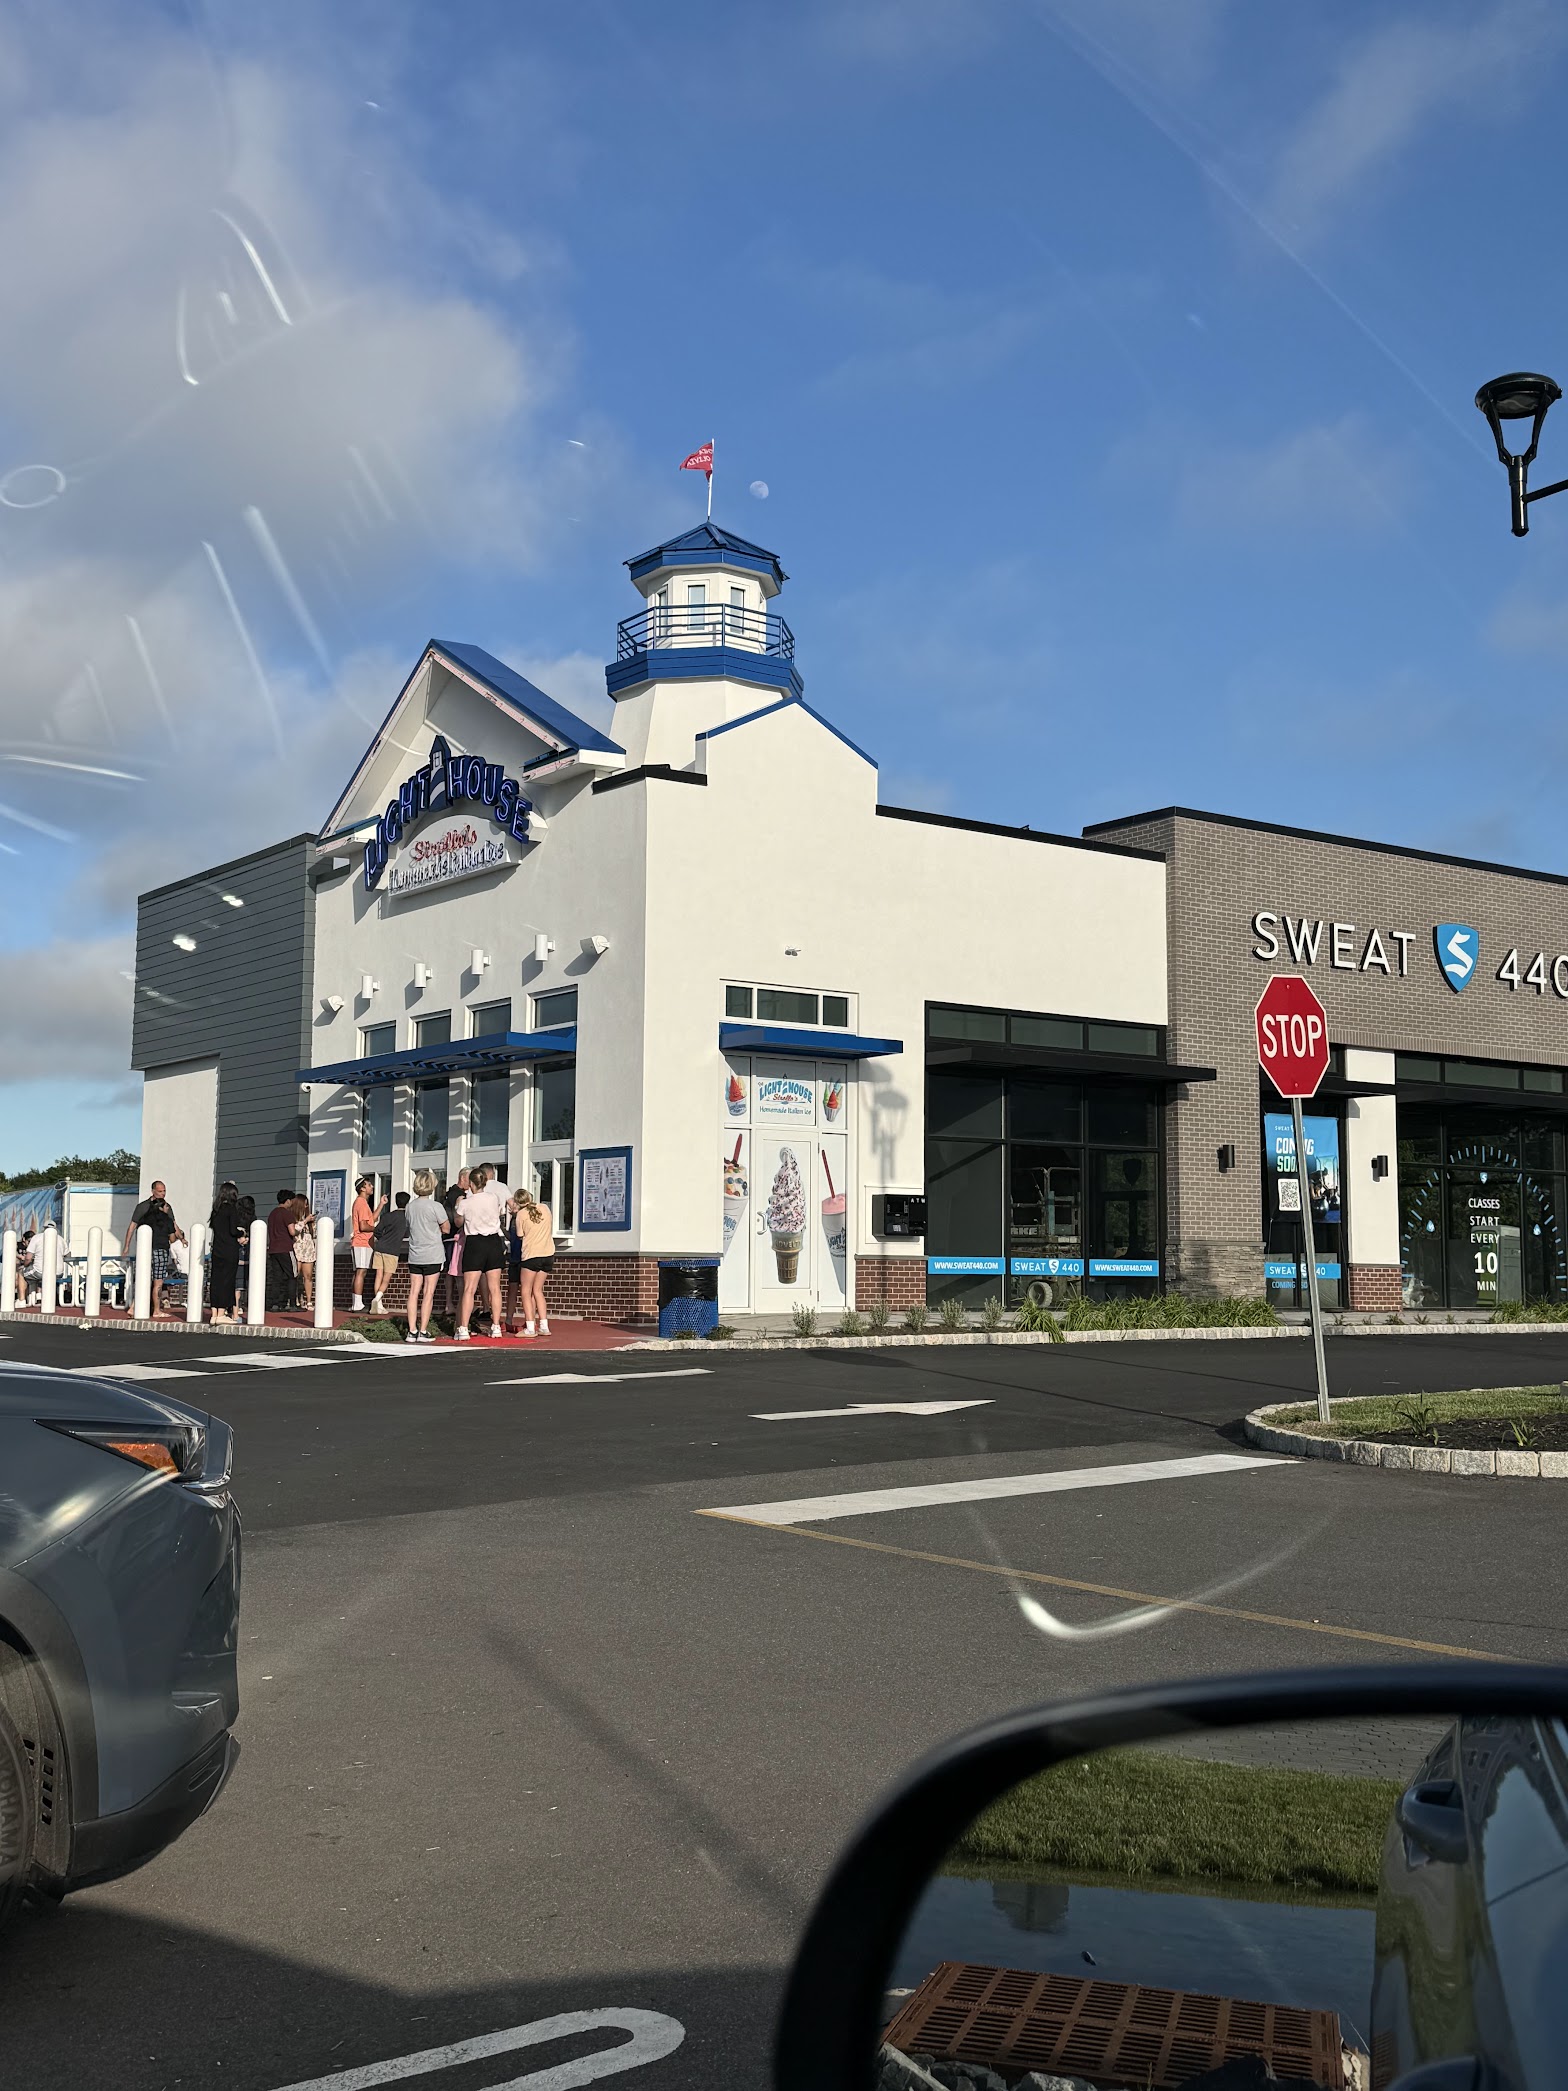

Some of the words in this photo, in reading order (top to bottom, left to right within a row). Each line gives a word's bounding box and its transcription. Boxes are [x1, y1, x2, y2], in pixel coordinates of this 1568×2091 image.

[363, 764, 431, 892] LIGHT
[448, 755, 533, 845] HOUSE
[1252, 911, 1416, 977] SWEAT
[1497, 948, 1568, 999] 440
[1262, 1013, 1323, 1058] STOP
[760, 1080, 782, 1101] LIGHT
[788, 1081, 812, 1103] HOUSE
[1276, 1155, 1298, 1173] SOO
[1468, 1198, 1500, 1210] CLASSES
[1469, 1216, 1500, 1227] START
[1470, 1233, 1500, 1244] EVERY
[934, 1261, 999, 1270] WWW.SWEAT440.COM
[1014, 1262, 1046, 1272] SWEAT
[1061, 1263, 1080, 1273] 440
[1094, 1263, 1153, 1272] WWW.SWEAT440.COM
[1474, 1252, 1498, 1274] 10
[1269, 1265, 1296, 1275] SWEAT
[1315, 1266, 1326, 1276] 40
[1271, 1281, 1296, 1289] COMING
[1476, 1281, 1496, 1291] MIN
